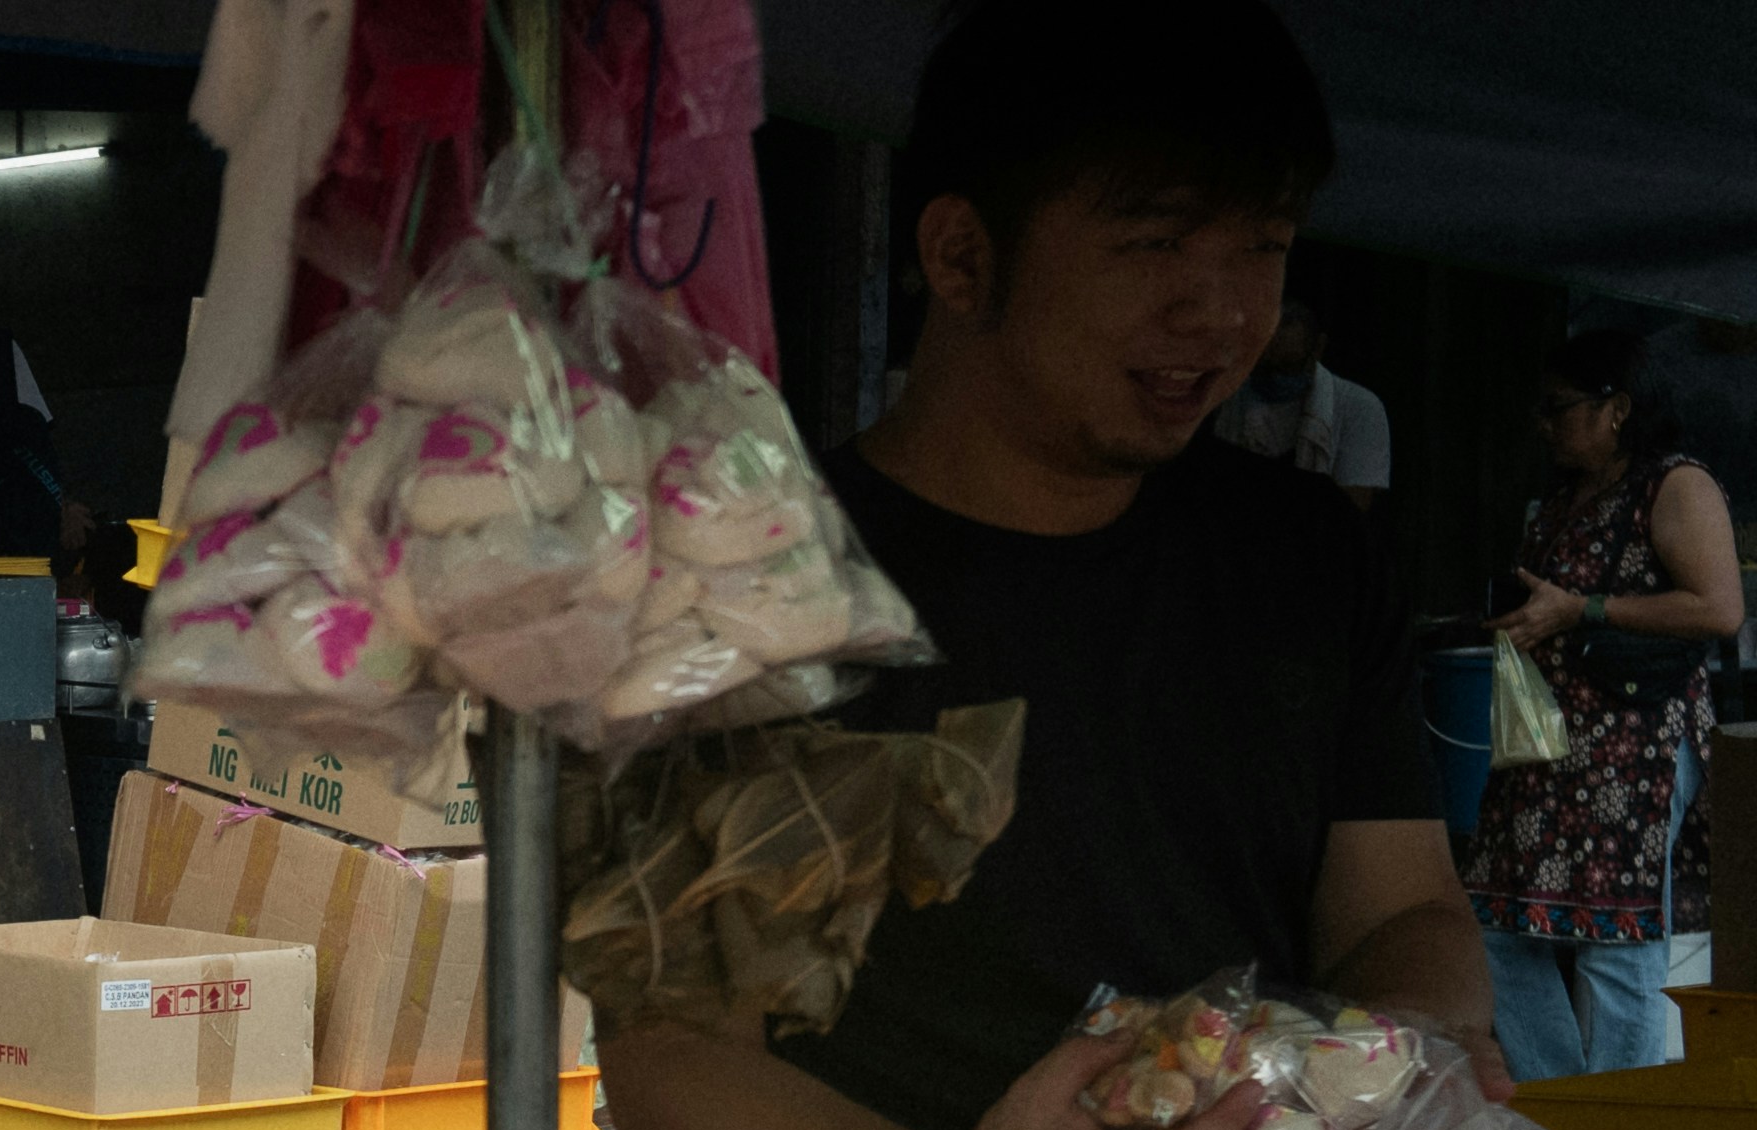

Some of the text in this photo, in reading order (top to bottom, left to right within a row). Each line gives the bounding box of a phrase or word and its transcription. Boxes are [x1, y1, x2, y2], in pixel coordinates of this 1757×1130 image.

[208, 743, 238, 782] NG
[299, 771, 344, 815] KOR
[444, 801, 459, 825] 12
[123, 991, 150, 1000] PANDAN
